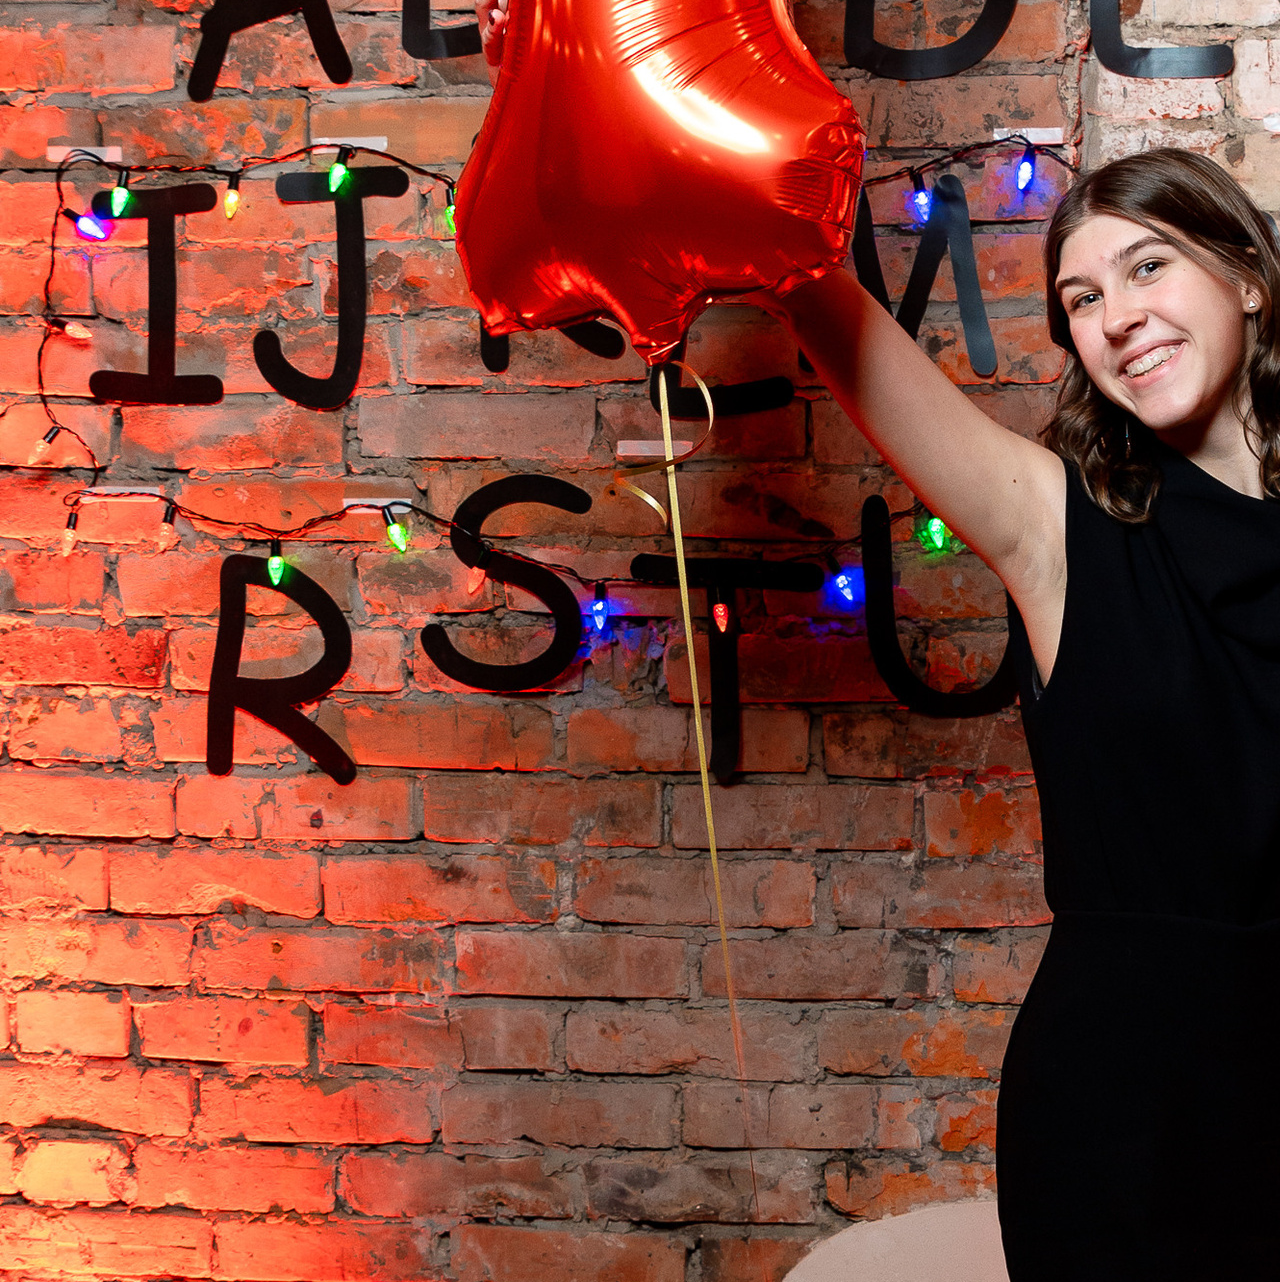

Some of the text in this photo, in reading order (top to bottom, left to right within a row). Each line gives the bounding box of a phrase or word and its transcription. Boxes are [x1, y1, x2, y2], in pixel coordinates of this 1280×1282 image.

[89, 183, 225, 406] I
[253, 167, 410, 412] J
[205, 553, 358, 787] R
[420, 474, 594, 692] S
[630, 553, 826, 785] T
